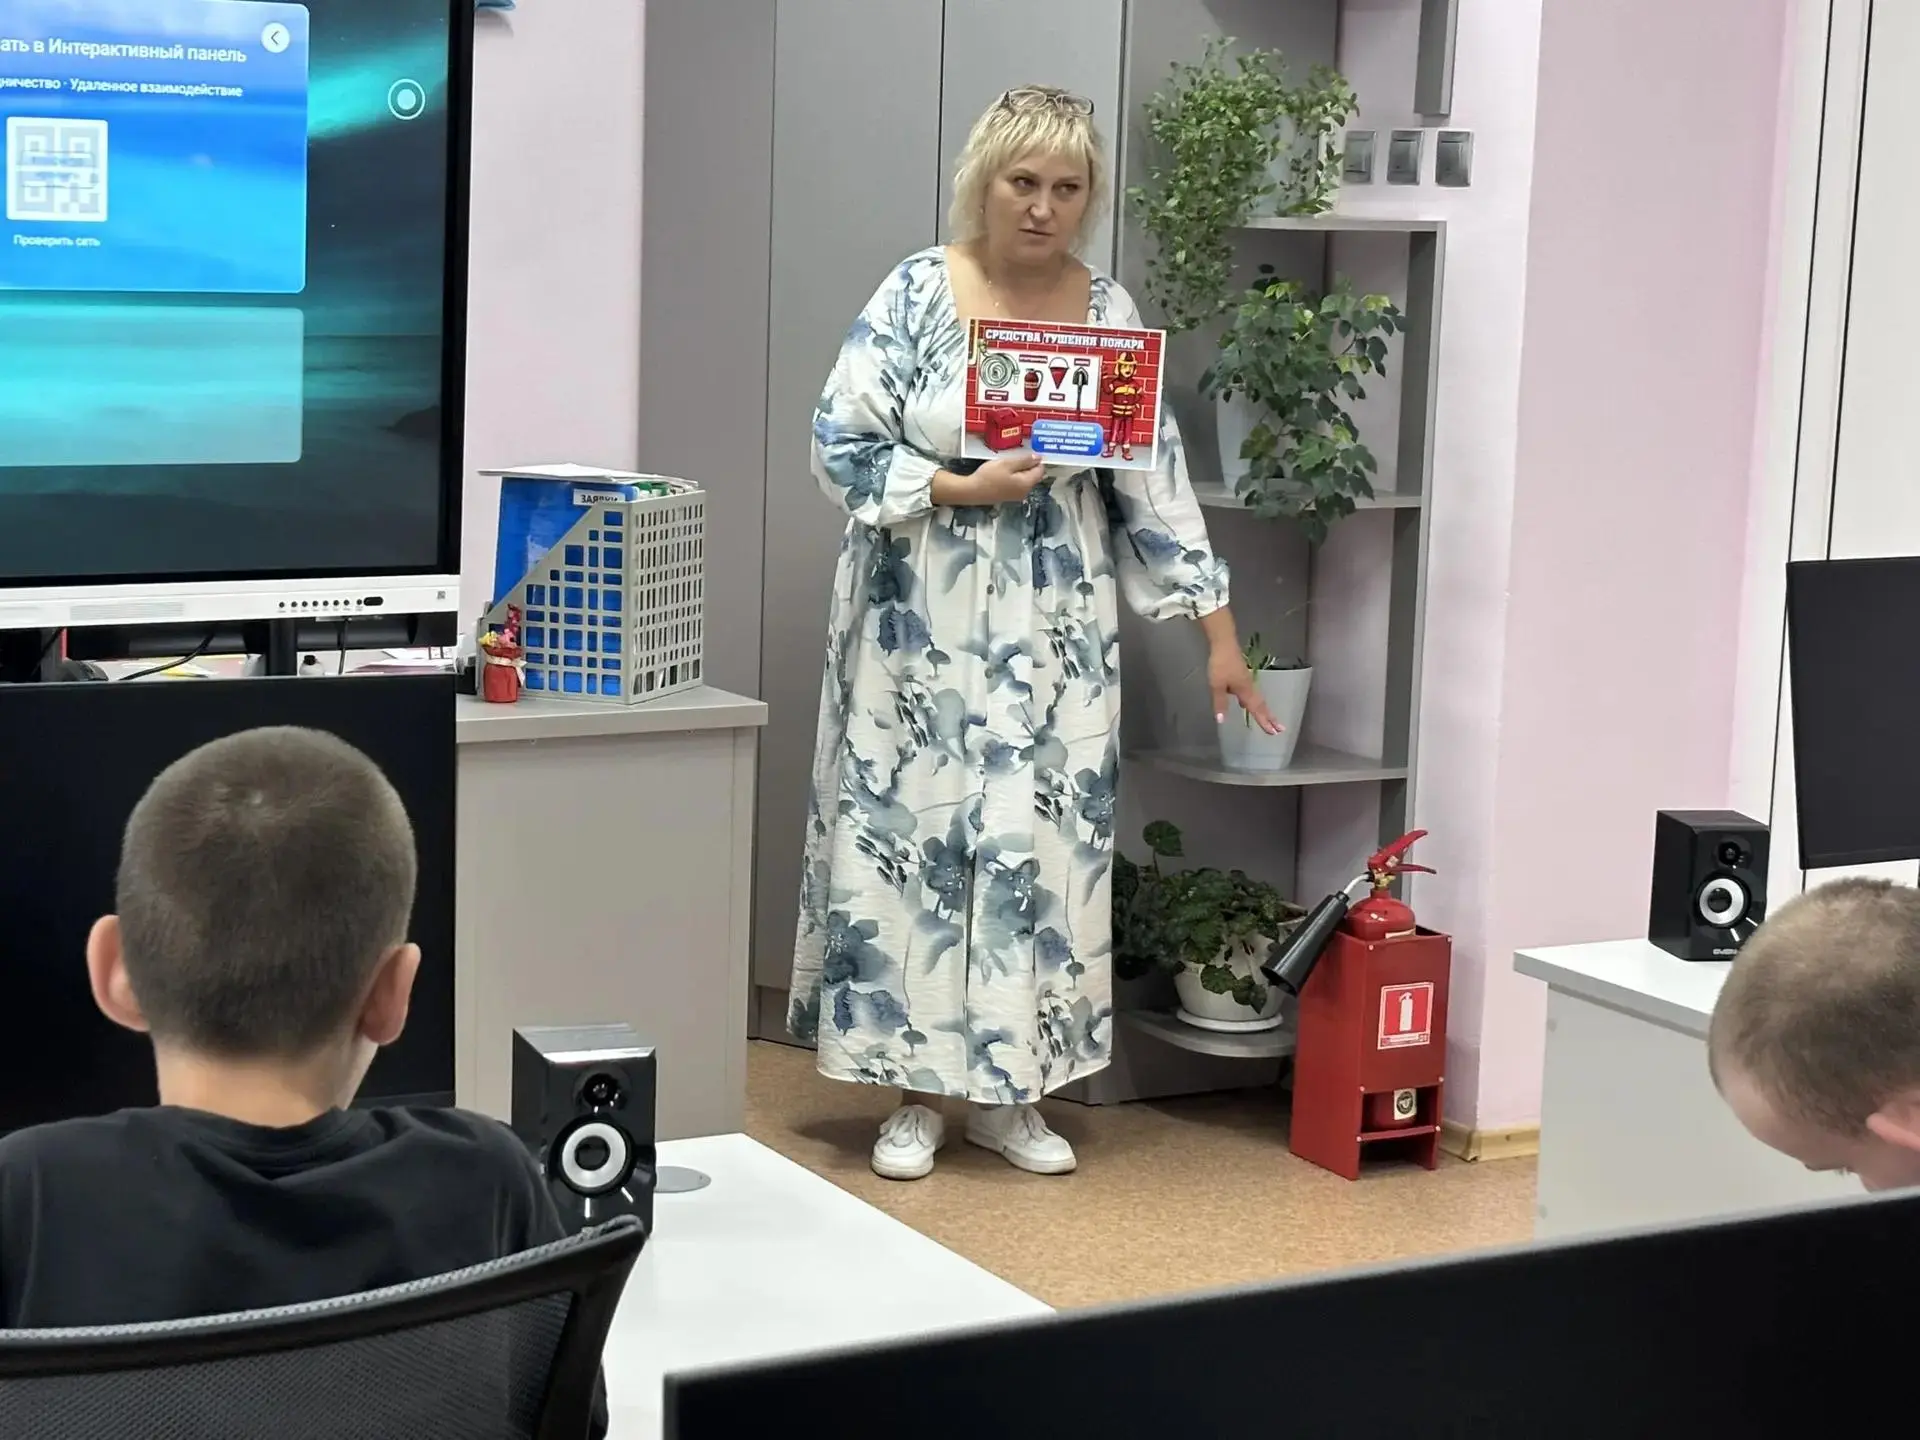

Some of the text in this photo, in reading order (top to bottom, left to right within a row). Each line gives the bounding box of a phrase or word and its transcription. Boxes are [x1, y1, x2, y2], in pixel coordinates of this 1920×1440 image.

[0, 38, 247, 62] ать в Интерактивный панель
[0, 77, 243, 97] ничество Удаленное взаимодействие
[985, 328, 1145, 350] СРЕДСТВА ТУШЕНИЯ ПОЖАРА
